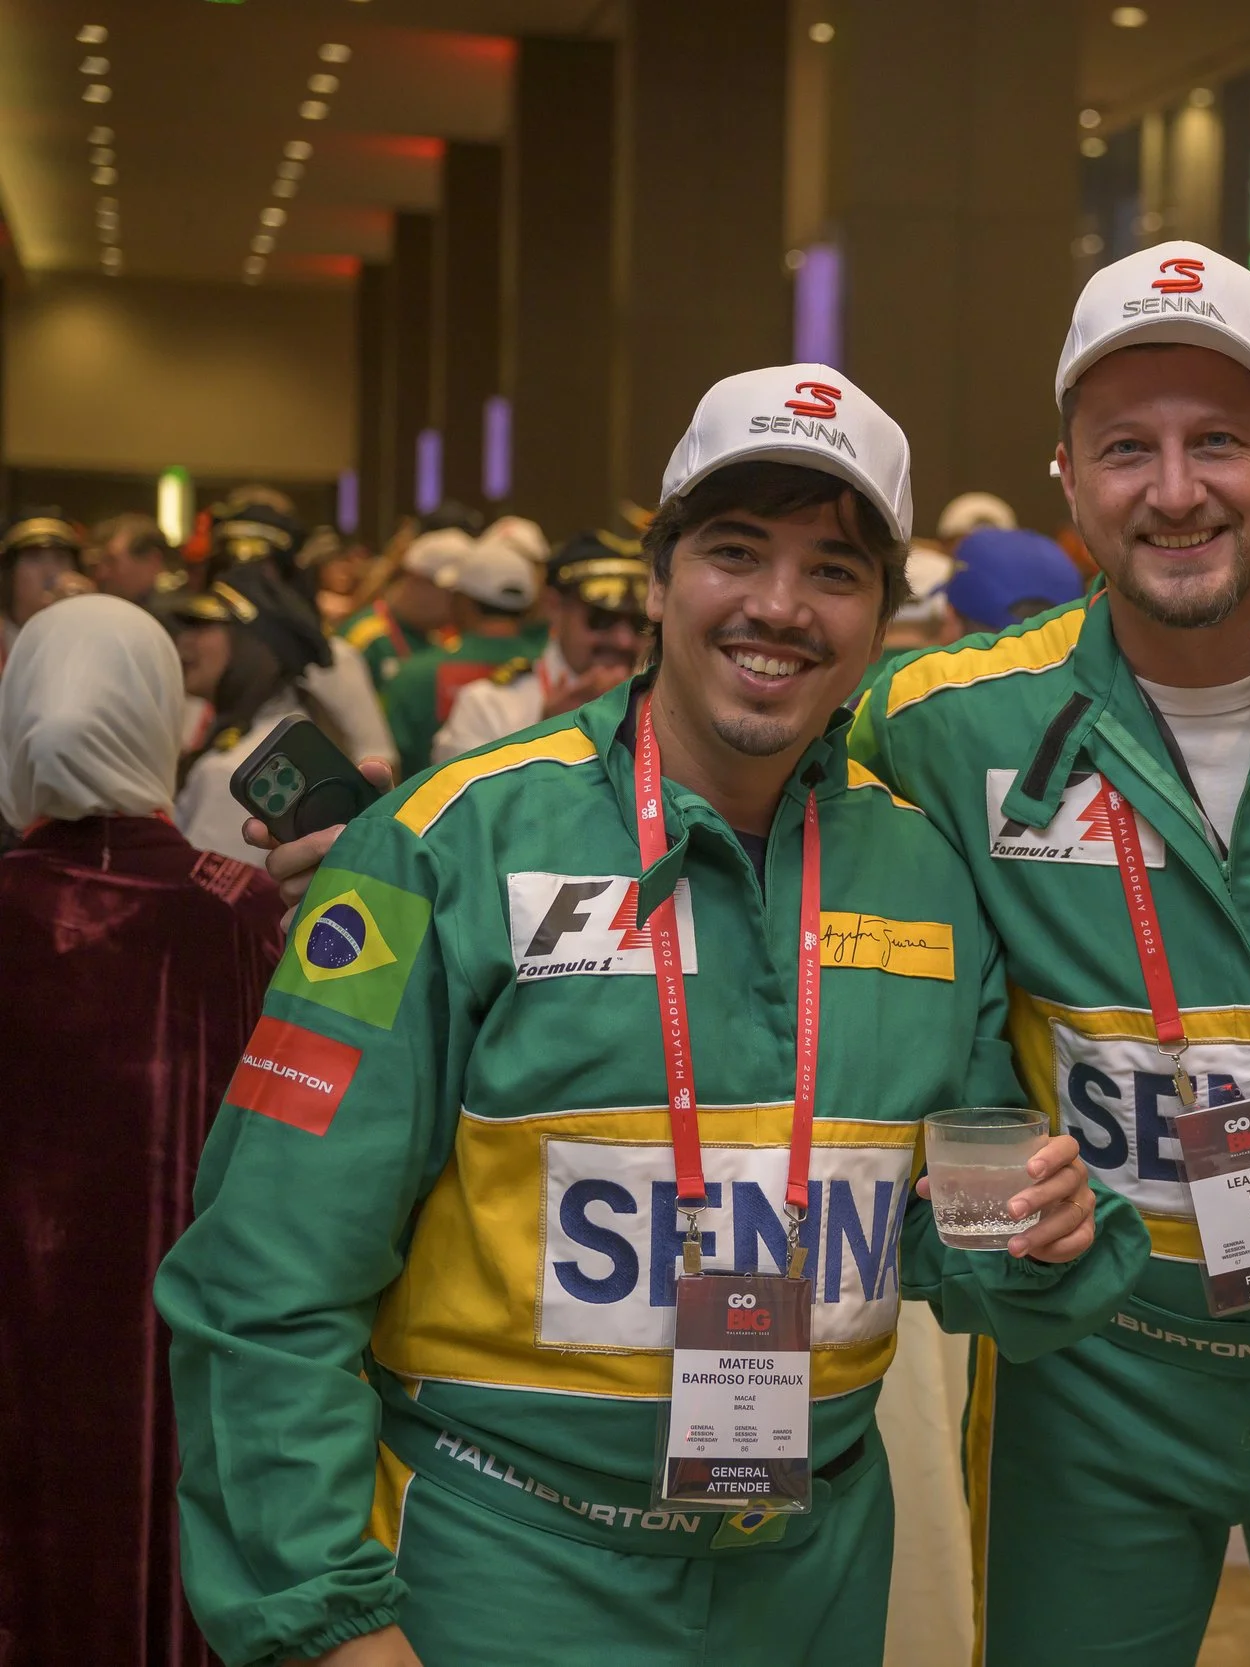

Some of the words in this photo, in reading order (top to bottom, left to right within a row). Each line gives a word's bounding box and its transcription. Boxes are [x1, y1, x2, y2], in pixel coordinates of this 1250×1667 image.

[1122, 296, 1227, 325] SENNA
[749, 415, 857, 459] SENNA
[647, 798, 658, 819] BIG
[1108, 790, 1121, 811] BIG
[991, 841, 1058, 859] Formula
[1060, 846, 1074, 859] 1
[1117, 817, 1146, 912] HALACADEMY
[1140, 920, 1156, 955] 2025
[660, 930, 673, 967] 2025
[804, 931, 813, 951] BIG
[517, 958, 598, 978] Formula
[599, 957, 613, 972] 1
[804, 959, 814, 1057] HALACADEMY
[666, 976, 684, 1080] HALACADEMY
[802, 1065, 811, 1101] 2025
[680, 1087, 691, 1109] BIG
[1224, 1116, 1250, 1134] GO
[1222, 1239, 1245, 1249] GENERAL
[1224, 1245, 1246, 1254] SESSION
[1221, 1250, 1250, 1260] WEDNESDAY
[728, 1293, 756, 1309] GO
[727, 1308, 771, 1331] BIG
[719, 1357, 774, 1370] MATEUS
[682, 1373, 744, 1385] BARROSO
[748, 1374, 804, 1386] FOURAUX
[434, 1429, 701, 1534] HALLIBURTON
[711, 1467, 769, 1478] GENERAL
[707, 1482, 771, 1493] ATTENDEE
